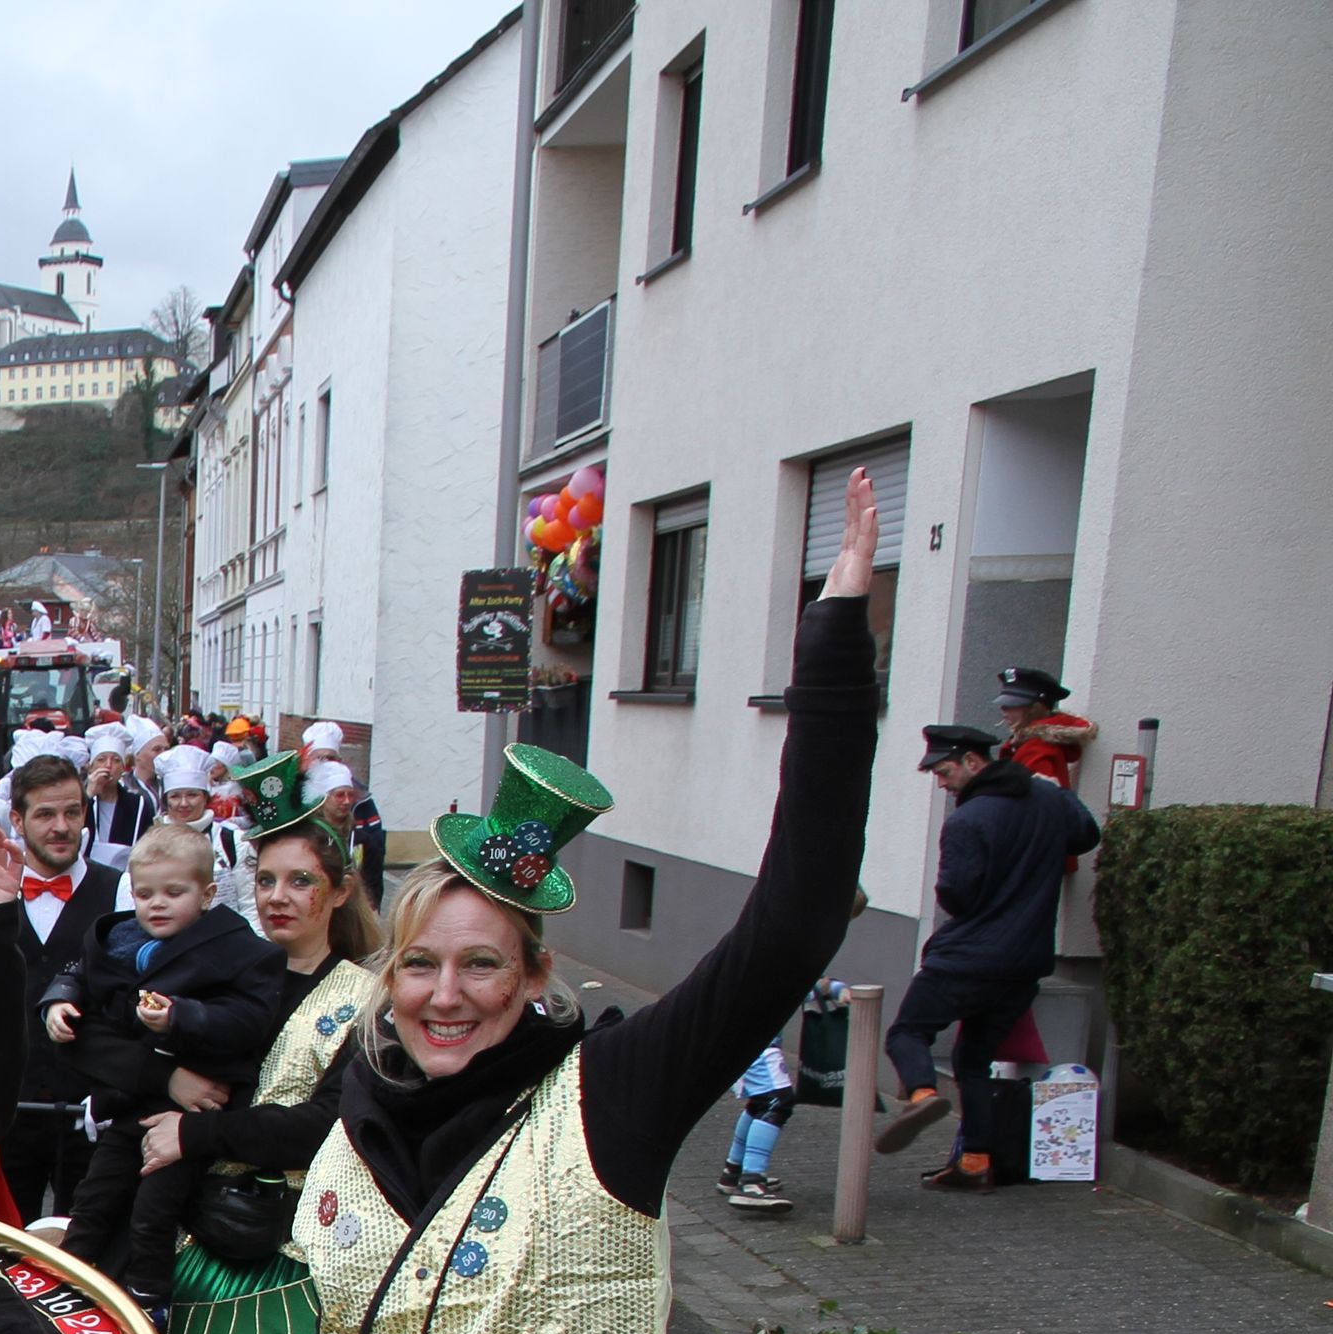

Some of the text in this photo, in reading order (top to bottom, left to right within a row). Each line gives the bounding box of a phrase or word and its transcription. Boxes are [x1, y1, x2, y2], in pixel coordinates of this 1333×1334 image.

[523, 833, 540, 846] 50
[489, 848, 507, 860] 100
[520, 865, 536, 879] 10
[322, 1202, 331, 1213] 10
[482, 1209, 496, 1220] 20
[343, 1225, 350, 1236] 5
[462, 1251, 477, 1266] 50
[11, 1270, 46, 1293] 33
[39, 1292, 82, 1312] 16
